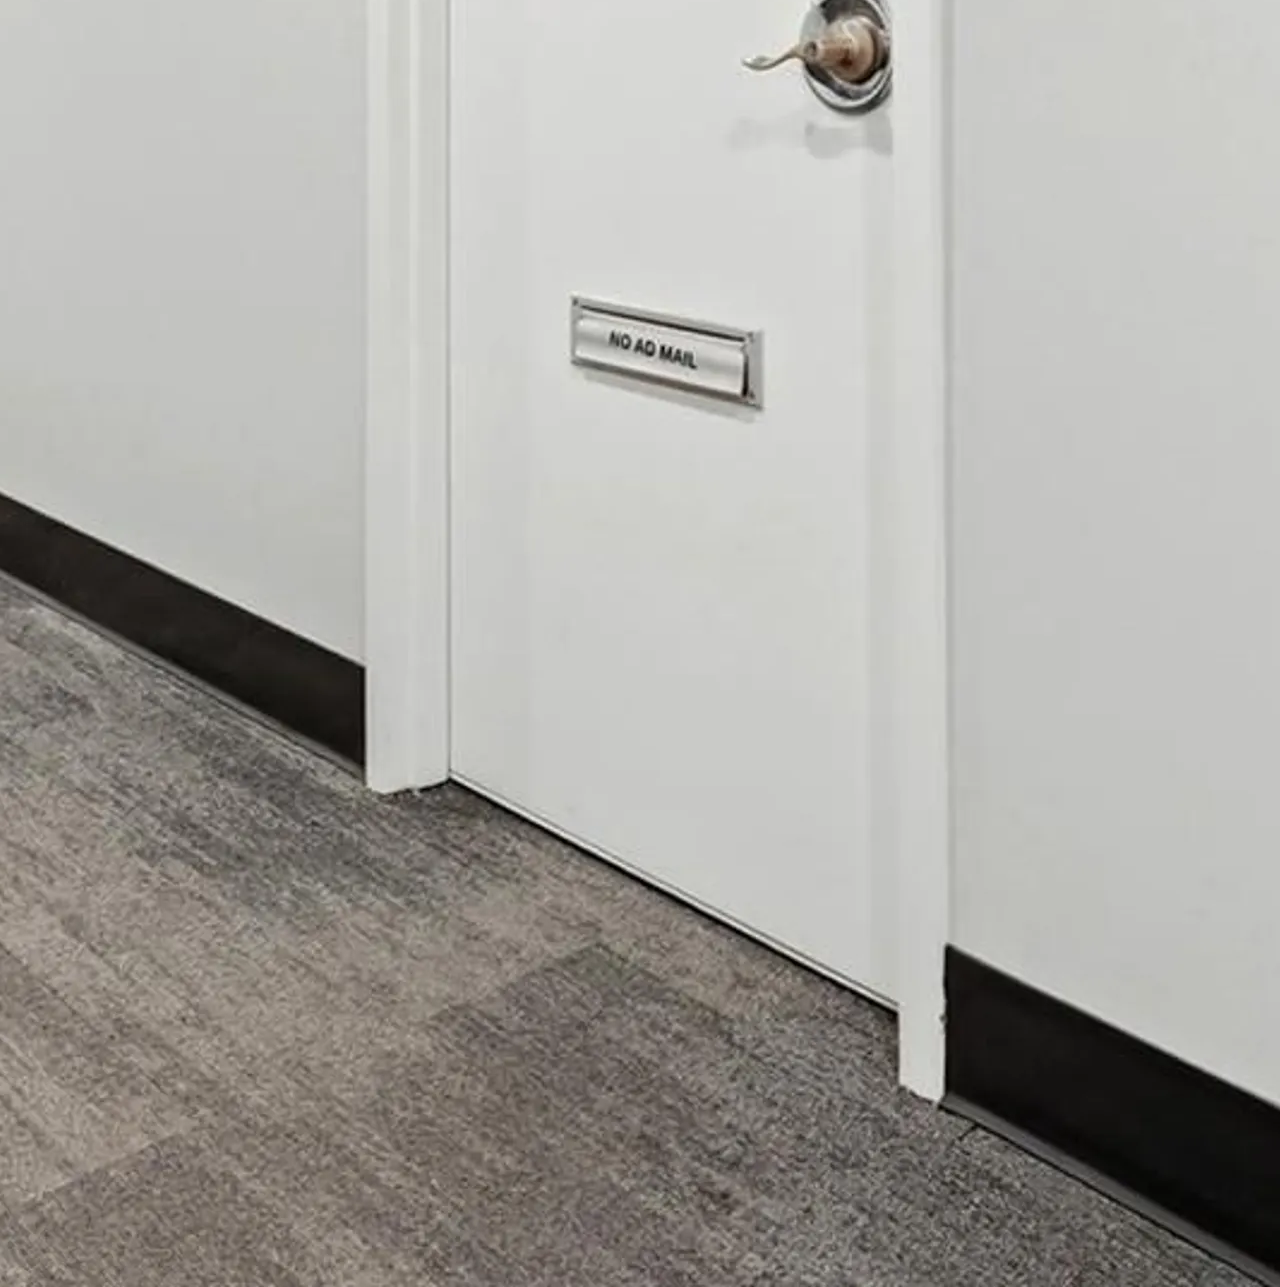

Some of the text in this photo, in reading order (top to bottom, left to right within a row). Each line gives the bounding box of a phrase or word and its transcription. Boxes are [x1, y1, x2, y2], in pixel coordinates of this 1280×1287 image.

[609, 330, 697, 369] NO AD MAIL
